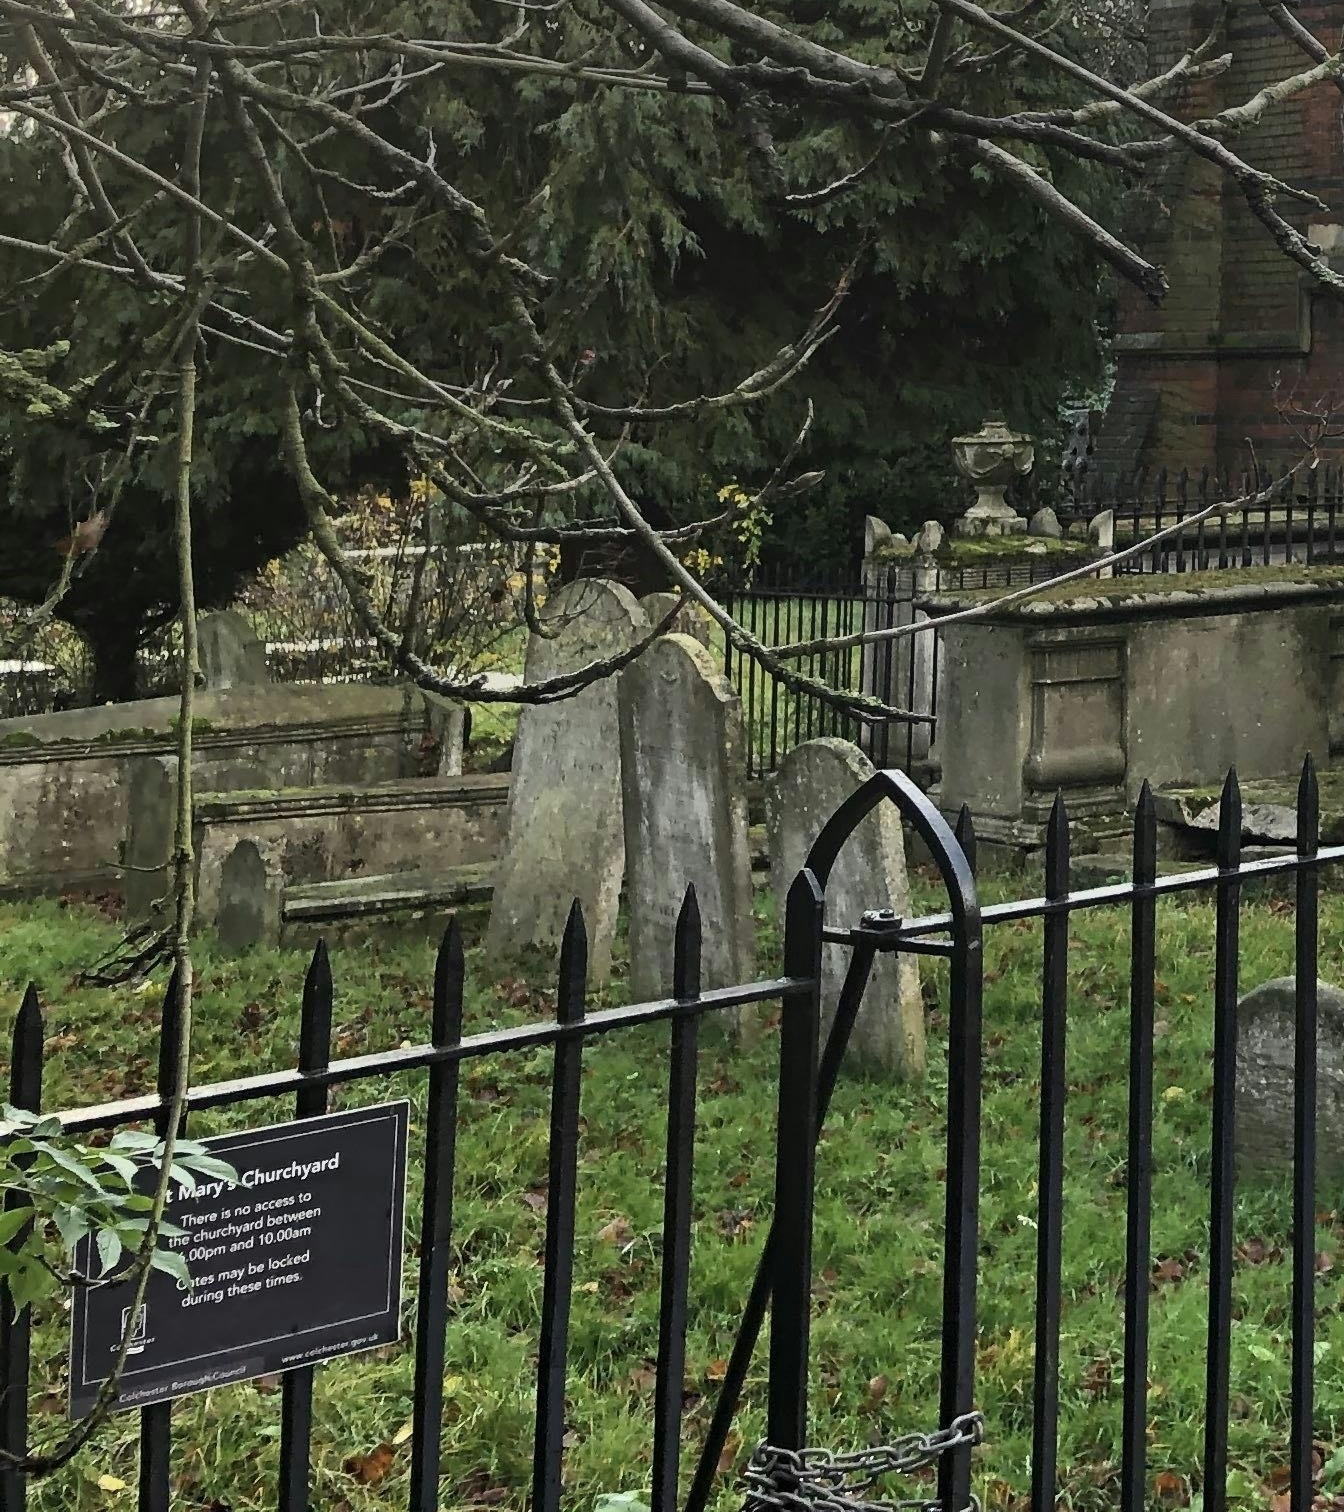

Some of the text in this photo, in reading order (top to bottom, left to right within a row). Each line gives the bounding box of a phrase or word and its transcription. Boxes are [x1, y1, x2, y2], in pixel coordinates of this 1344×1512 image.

[178, 1177, 236, 1203] Mary's
[241, 1152, 341, 1190] Churchyard
[168, 1206, 322, 1249] the churchyard between
[180, 1192, 312, 1228] There is no access to
[229, 1237, 254, 1253] and
[258, 1226, 312, 1246] 10.00am
[218, 1266, 245, 1284] may
[248, 1262, 265, 1276] be
[268, 1249, 311, 1270] locked
[181, 1272, 303, 1308] during these times.
[119, 1365, 247, 1403] Colchester Borough Council
